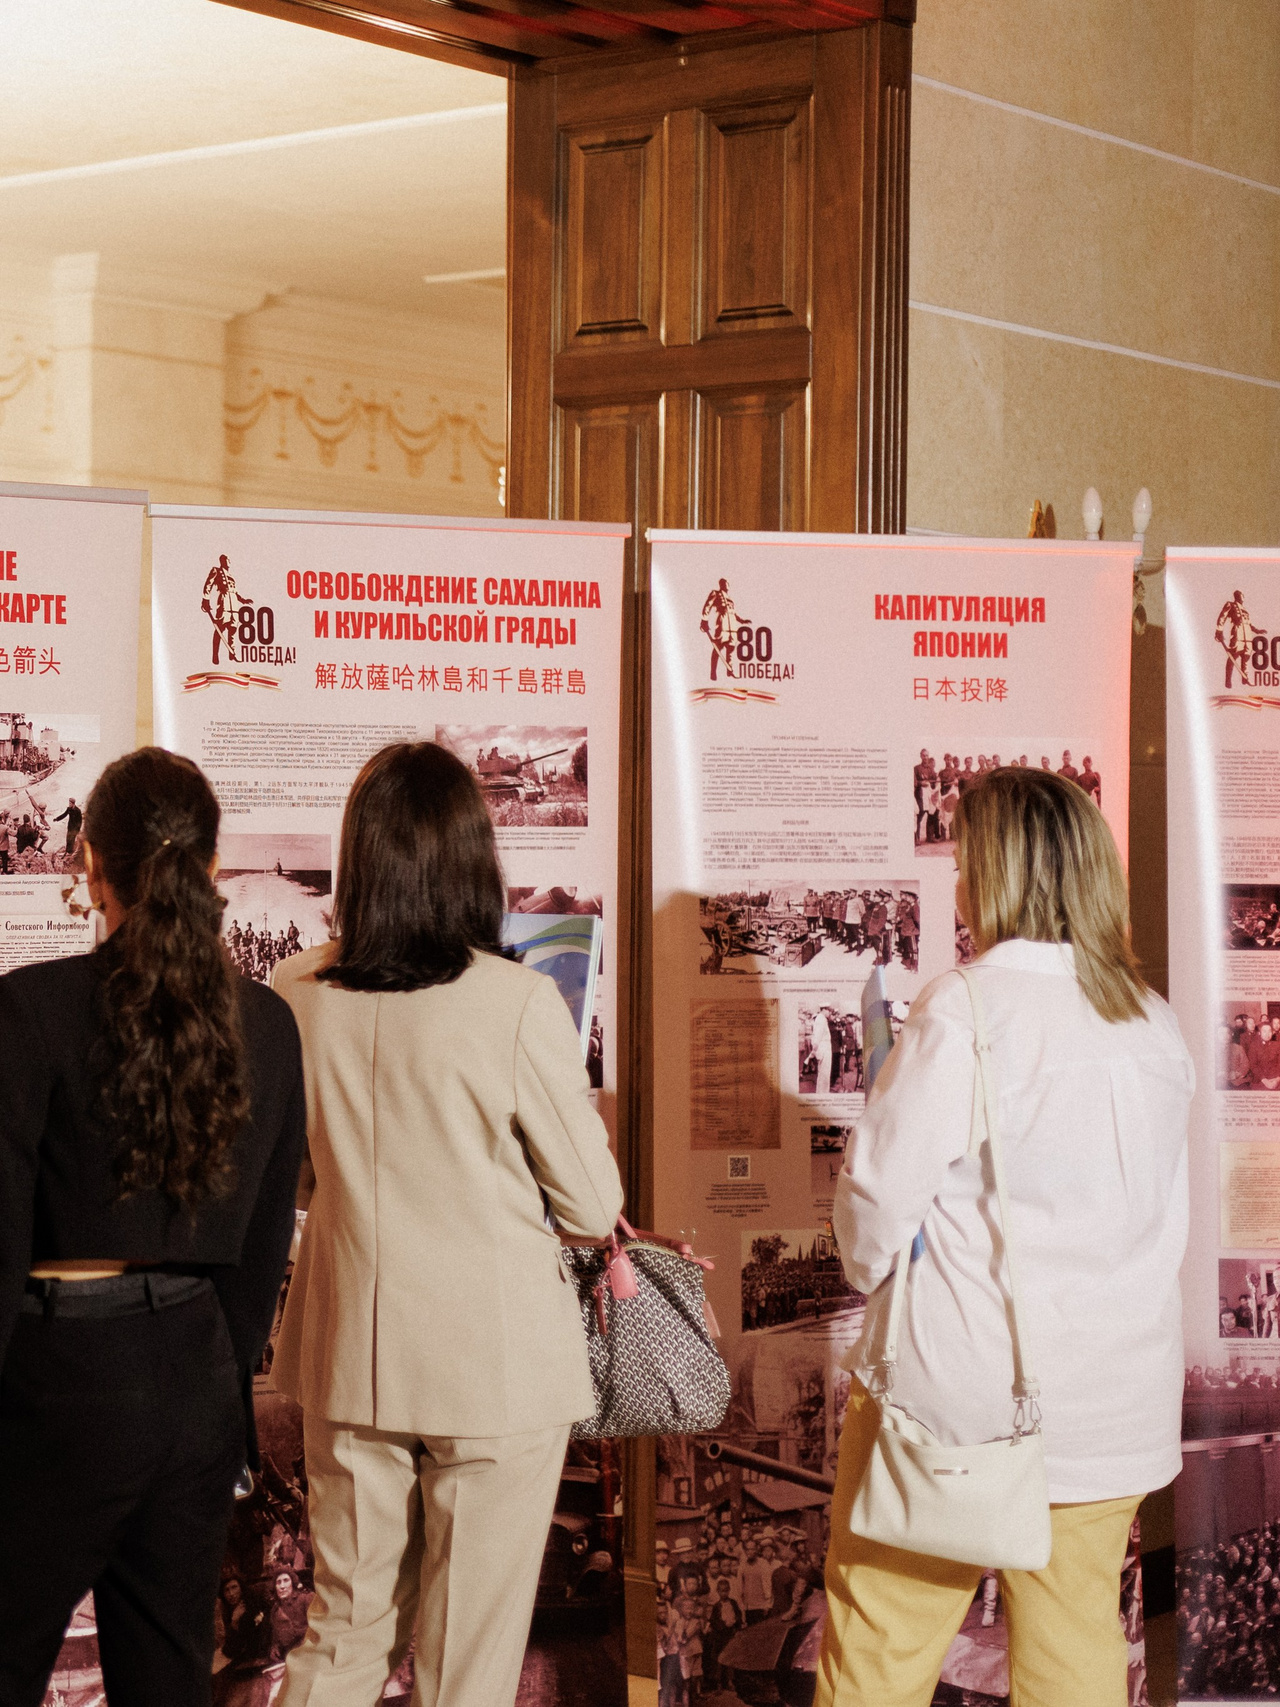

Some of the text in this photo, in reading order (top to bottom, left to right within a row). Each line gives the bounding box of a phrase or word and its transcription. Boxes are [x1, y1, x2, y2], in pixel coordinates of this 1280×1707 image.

[286, 570, 602, 609] ОСВОБОЖДЕНИЕ САХАЛИНА
[238, 607, 275, 646] 80
[874, 594, 1046, 627] КАПИТУЛЯЦИЯ
[314, 609, 577, 650] И КУРИЛЬСКОЙ ГРЯДЫ
[737, 626, 773, 663] 80
[913, 631, 1008, 659] ЯПОНИИ
[240, 645, 296, 667] ПОБЕДА!
[739, 662, 795, 682] ПОБЕДА!
[314, 663, 587, 695] 解放薩哈林島和千島群島
[912, 677, 1009, 703] 日本投降
[5, 920, 43, 932] Советского
[46, 920, 90, 932] Информбюро
